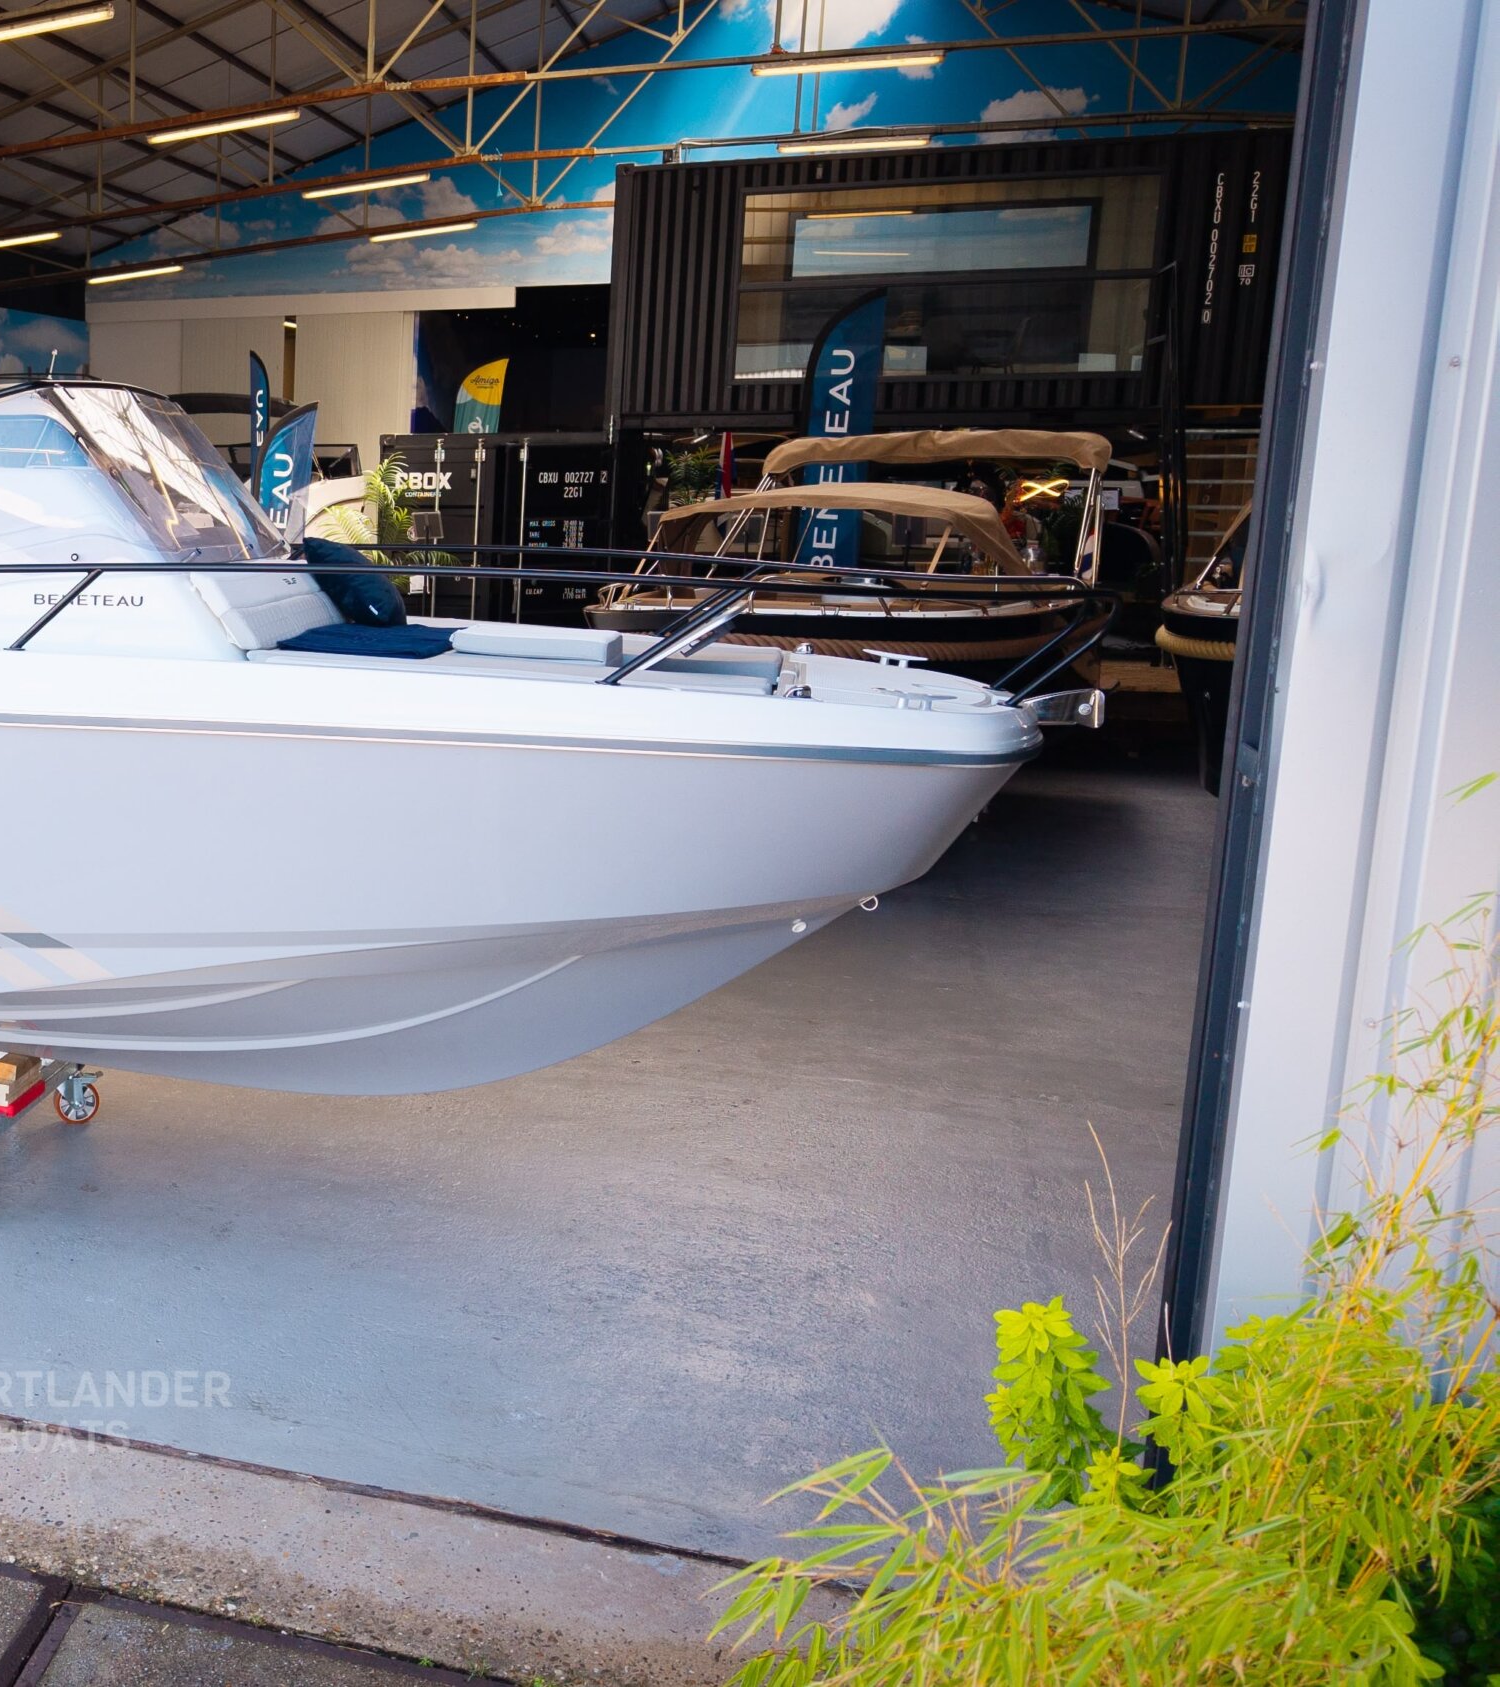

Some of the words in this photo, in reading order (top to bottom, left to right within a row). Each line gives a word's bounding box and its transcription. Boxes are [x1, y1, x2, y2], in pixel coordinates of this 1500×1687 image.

[1213, 172, 1225, 224] CBXU
[1250, 170, 1261, 223] 22G1
[1204, 228, 1219, 305] 002702
[538, 472, 559, 484] CBXU
[565, 472, 594, 484] 002727
[601, 471, 608, 483] 2
[810, 349, 856, 567] BENEEAU
[563, 487, 583, 498] 22G1
